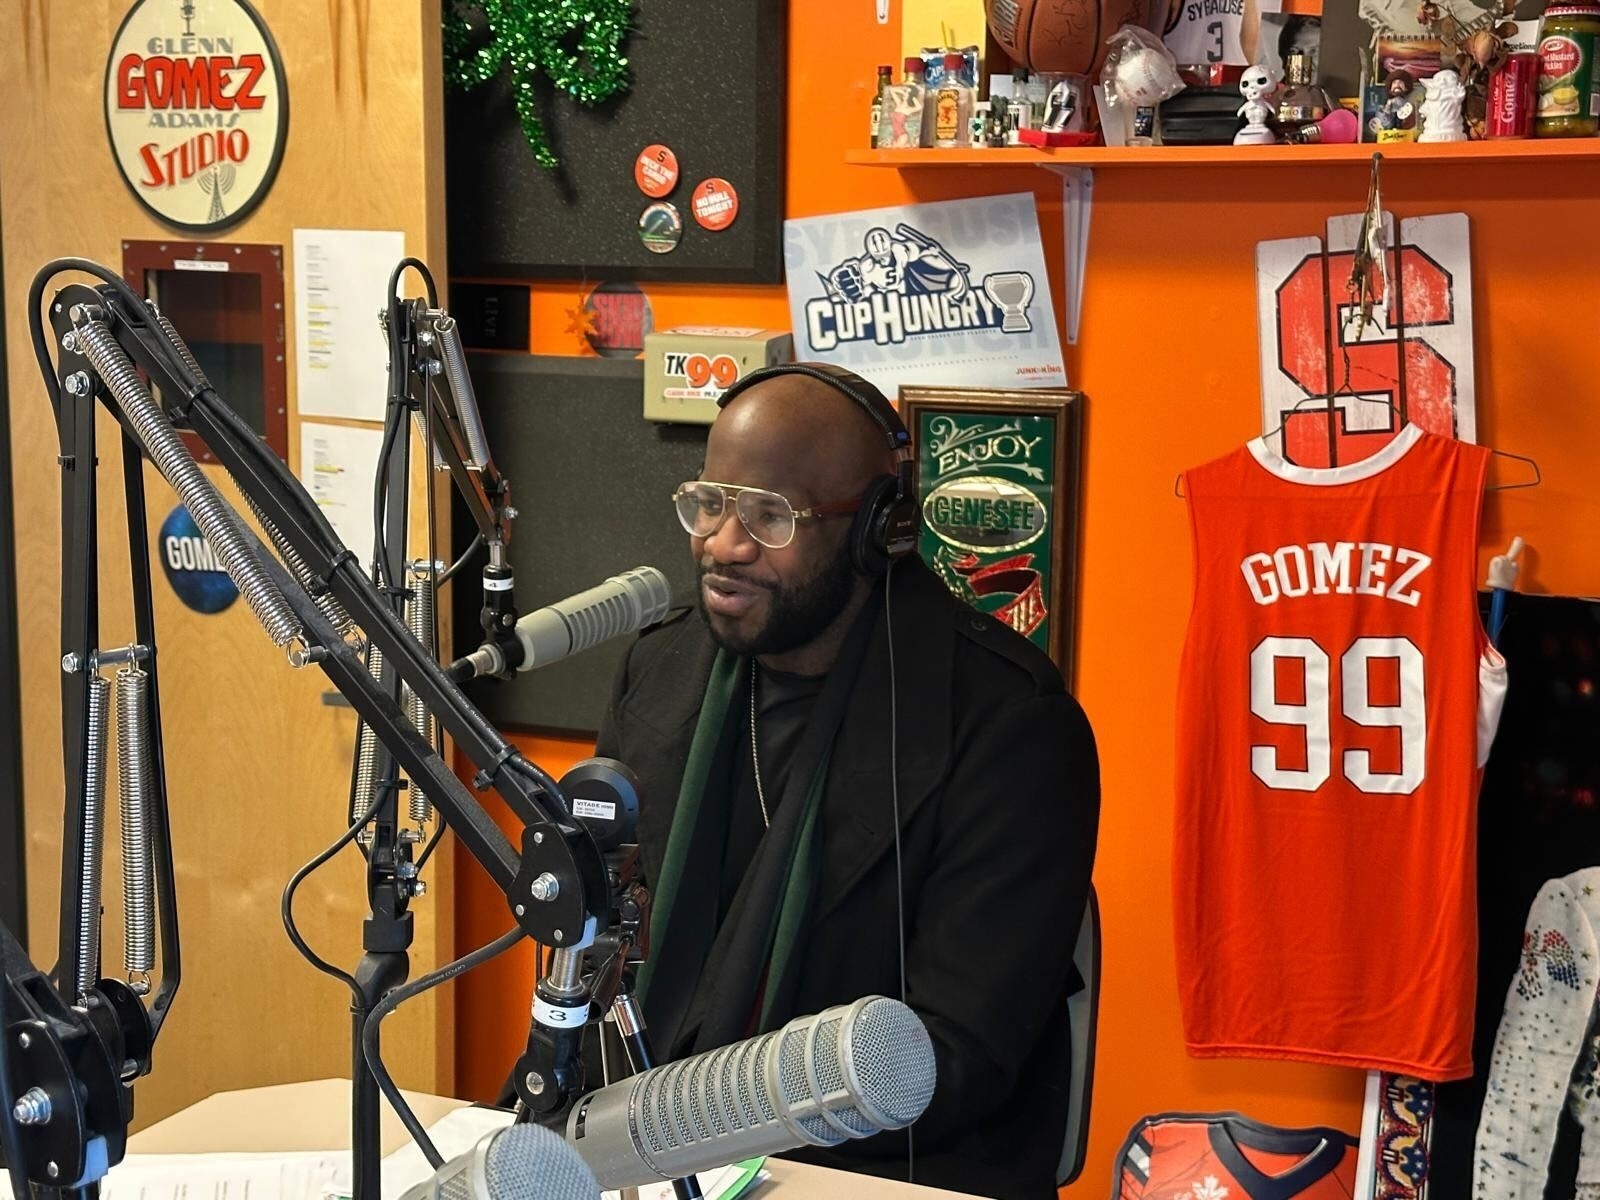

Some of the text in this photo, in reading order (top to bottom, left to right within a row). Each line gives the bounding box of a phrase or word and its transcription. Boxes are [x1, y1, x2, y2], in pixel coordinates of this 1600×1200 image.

[147, 37, 234, 54] GLENN
[1207, 21, 1224, 62] 3
[117, 53, 266, 110] GOMEZ
[1500, 72, 1515, 123] Gomez
[148, 112, 240, 128] ADAMS
[139, 128, 250, 188] STUDIO
[657, 150, 668, 163] S
[937, 435, 1042, 475] ENJOY
[932, 495, 1035, 531] GENESEE
[165, 535, 227, 572] GOM
[1240, 541, 1432, 607] GOMEZ
[1249, 635, 1427, 796] 99
[548, 1009, 568, 1022] 3
